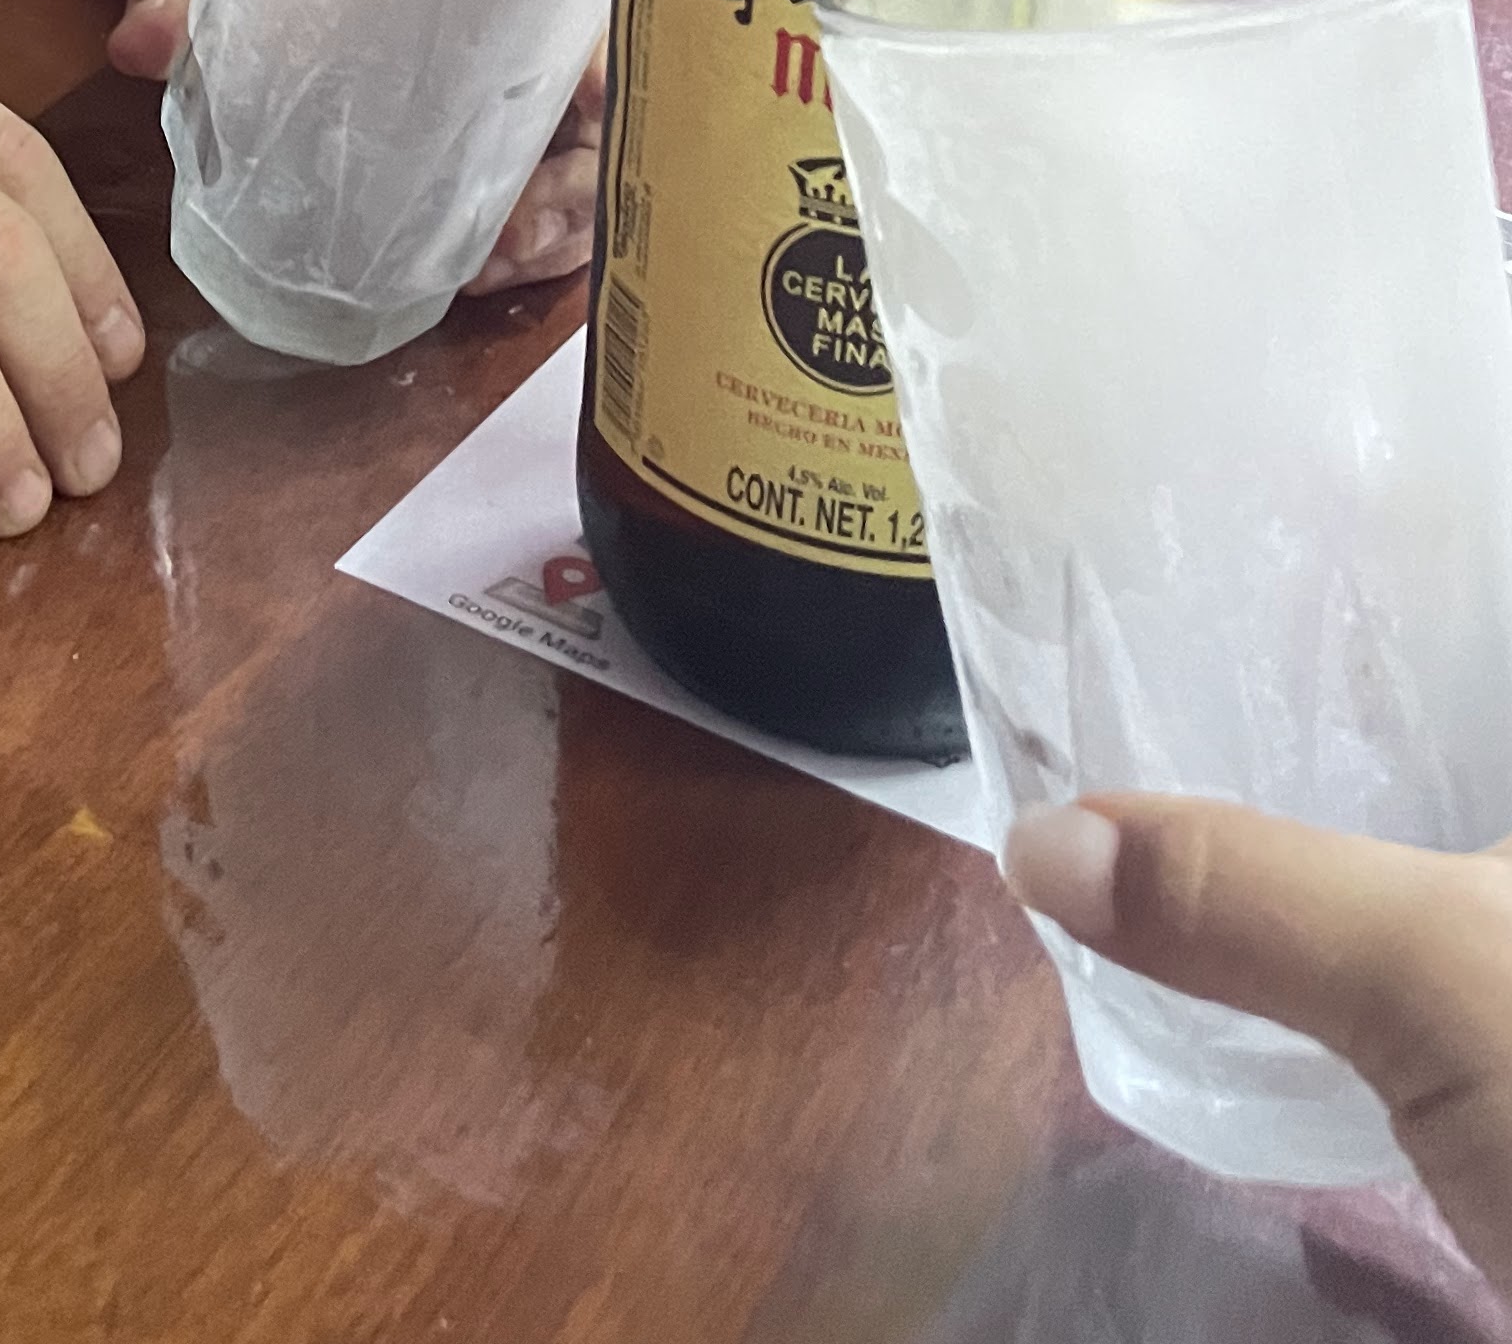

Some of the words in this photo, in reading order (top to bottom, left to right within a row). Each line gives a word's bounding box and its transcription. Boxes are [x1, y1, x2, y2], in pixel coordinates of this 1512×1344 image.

[782, 270, 870, 312] CERV
[812, 333, 891, 372] FINA
[716, 371, 866, 433] CERVECERIA
[748, 410, 817, 444] HECHO
[823, 433, 850, 452] EN
[859, 442, 909, 460] MEX
[726, 466, 805, 526] CONT.
[815, 496, 875, 542] NET.
[448, 593, 534, 637] Google
[539, 632, 611, 670] Maps
